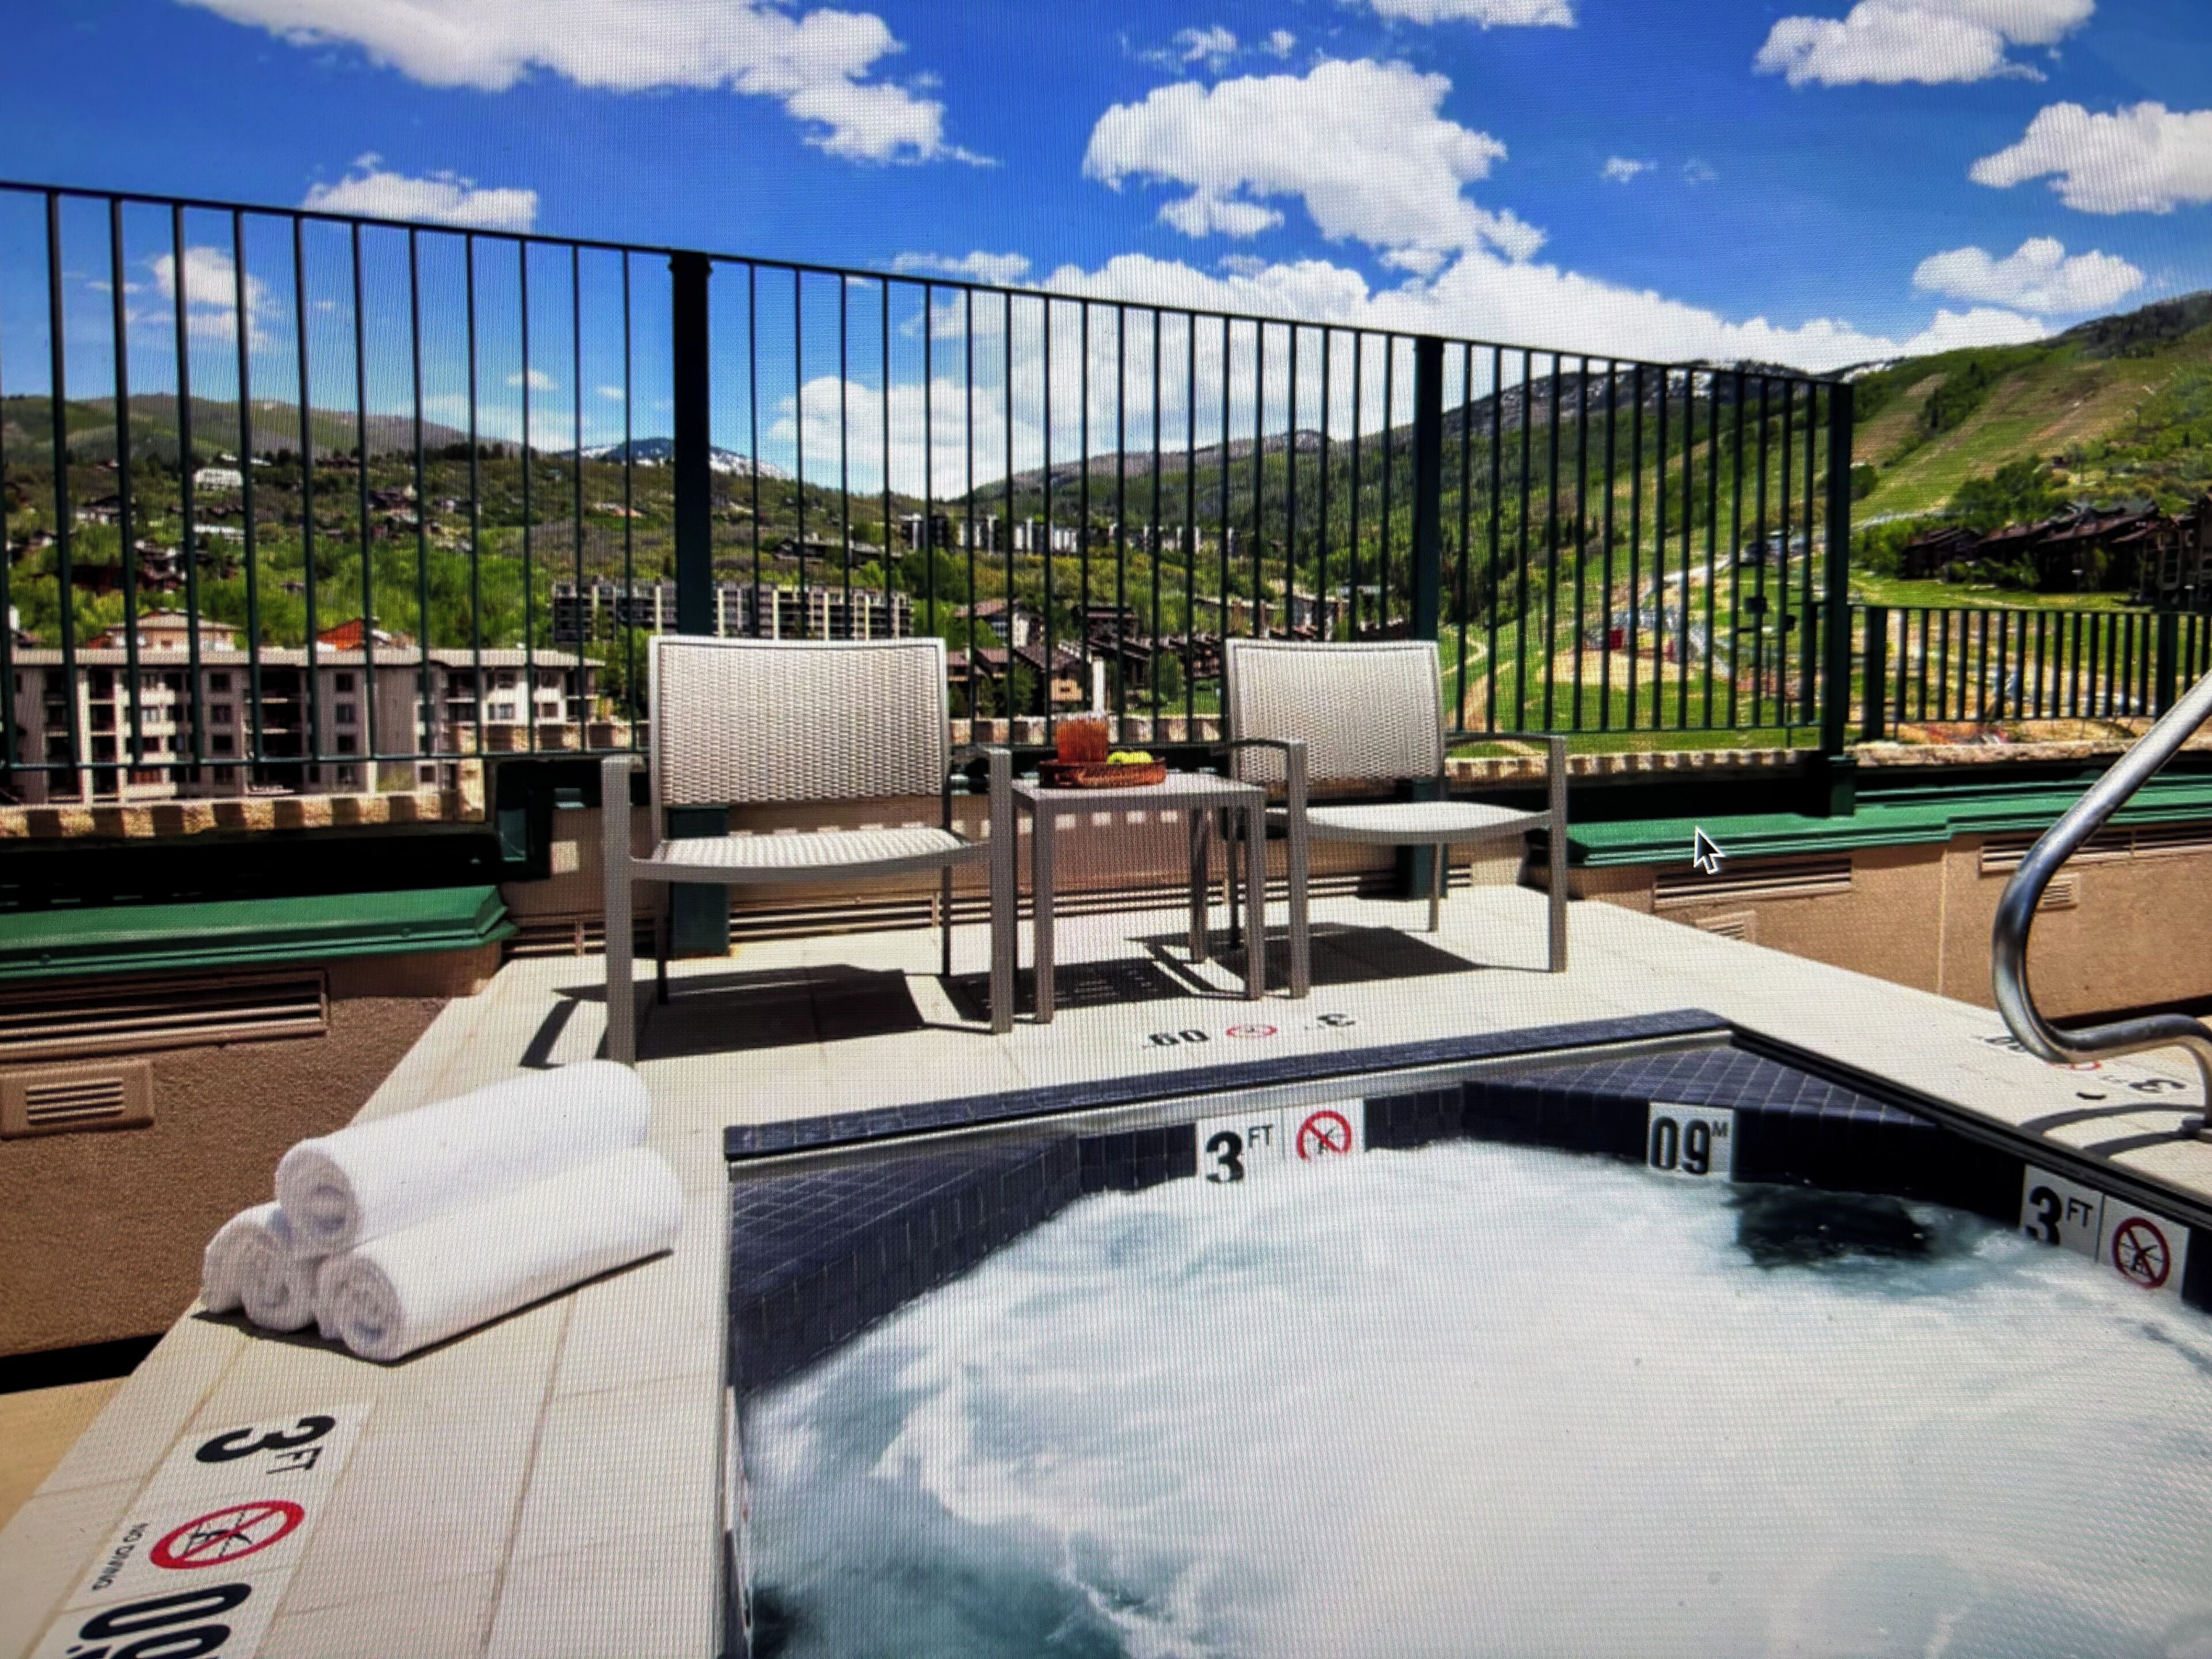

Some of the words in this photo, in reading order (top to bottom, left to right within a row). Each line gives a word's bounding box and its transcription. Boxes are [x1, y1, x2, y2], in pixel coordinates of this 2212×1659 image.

[1206, 1131, 1244, 1183] 3
[1248, 1124, 1274, 1148] FT
[1650, 1117, 1710, 1175] 09
[2024, 1187, 2062, 1245] 3
[2067, 1196, 2093, 1227] FT
[195, 1415, 336, 1463] 3
[266, 1446, 323, 1475] FT
